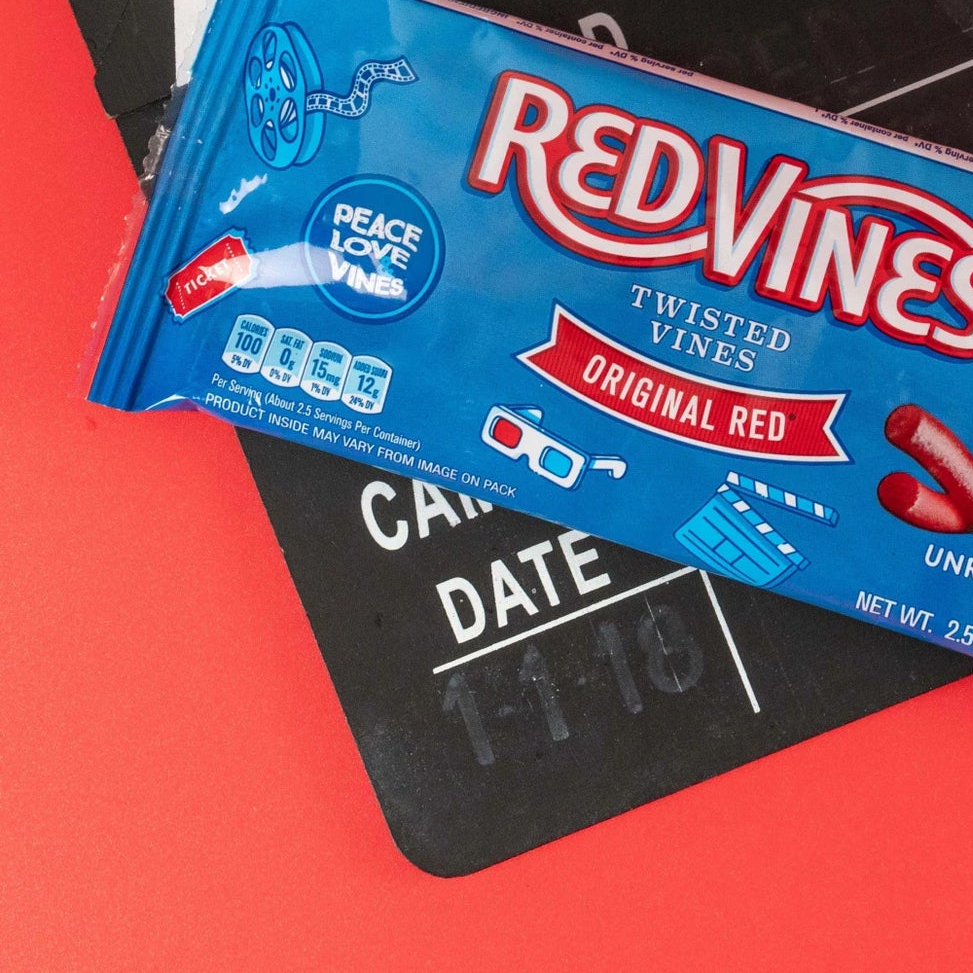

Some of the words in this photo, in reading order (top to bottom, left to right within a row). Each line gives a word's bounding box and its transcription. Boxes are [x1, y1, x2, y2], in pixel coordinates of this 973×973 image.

[545, 27, 587, 44] container
[588, 42, 604, 50] per
[641, 57, 677, 73] serving
[678, 67, 694, 77] per
[850, 120, 892, 137] container
[892, 132, 909, 142] per
[468, 71, 708, 262] RED
[332, 203, 423, 252] PEACE
[329, 229, 411, 270] LOVE
[184, 258, 229, 296] TICKET
[327, 251, 405, 298] VINES
[240, 319, 269, 338] CALORIES
[630, 284, 791, 352] TWISTED
[234, 331, 263, 355] 100
[293, 337, 305, 349] FAT
[651, 320, 757, 372] VINES
[230, 354, 242, 366] 5%
[279, 347, 296, 371] 0g
[311, 358, 341, 387] 15mg
[311, 382, 321, 394] 1%
[357, 374, 380, 399] 12g
[582, 354, 715, 431] ORIGINAL
[728, 405, 786, 441] RED
[211, 372, 226, 387] Per
[229, 379, 263, 401] Serving
[264, 391, 295, 412] (About
[297, 402, 312, 417] 2.5
[313, 407, 353, 429] Servings
[354, 420, 371, 435] Per
[373, 425, 421, 452] Container)
[349, 394, 365, 407] 24%
[205, 392, 266, 421] PRODUCT
[268, 412, 310, 435] INSIDE
[312, 426, 341, 444] MAY
[342, 435, 375, 454] VARY
[376, 446, 414, 467] FROM
[417, 458, 459, 480] IMAGE
[461, 472, 480, 487] ON
[483, 478, 517, 499] PACK
[435, 530, 611, 644] DATE
[855, 591, 897, 618] NET
[900, 604, 935, 634] WT.
